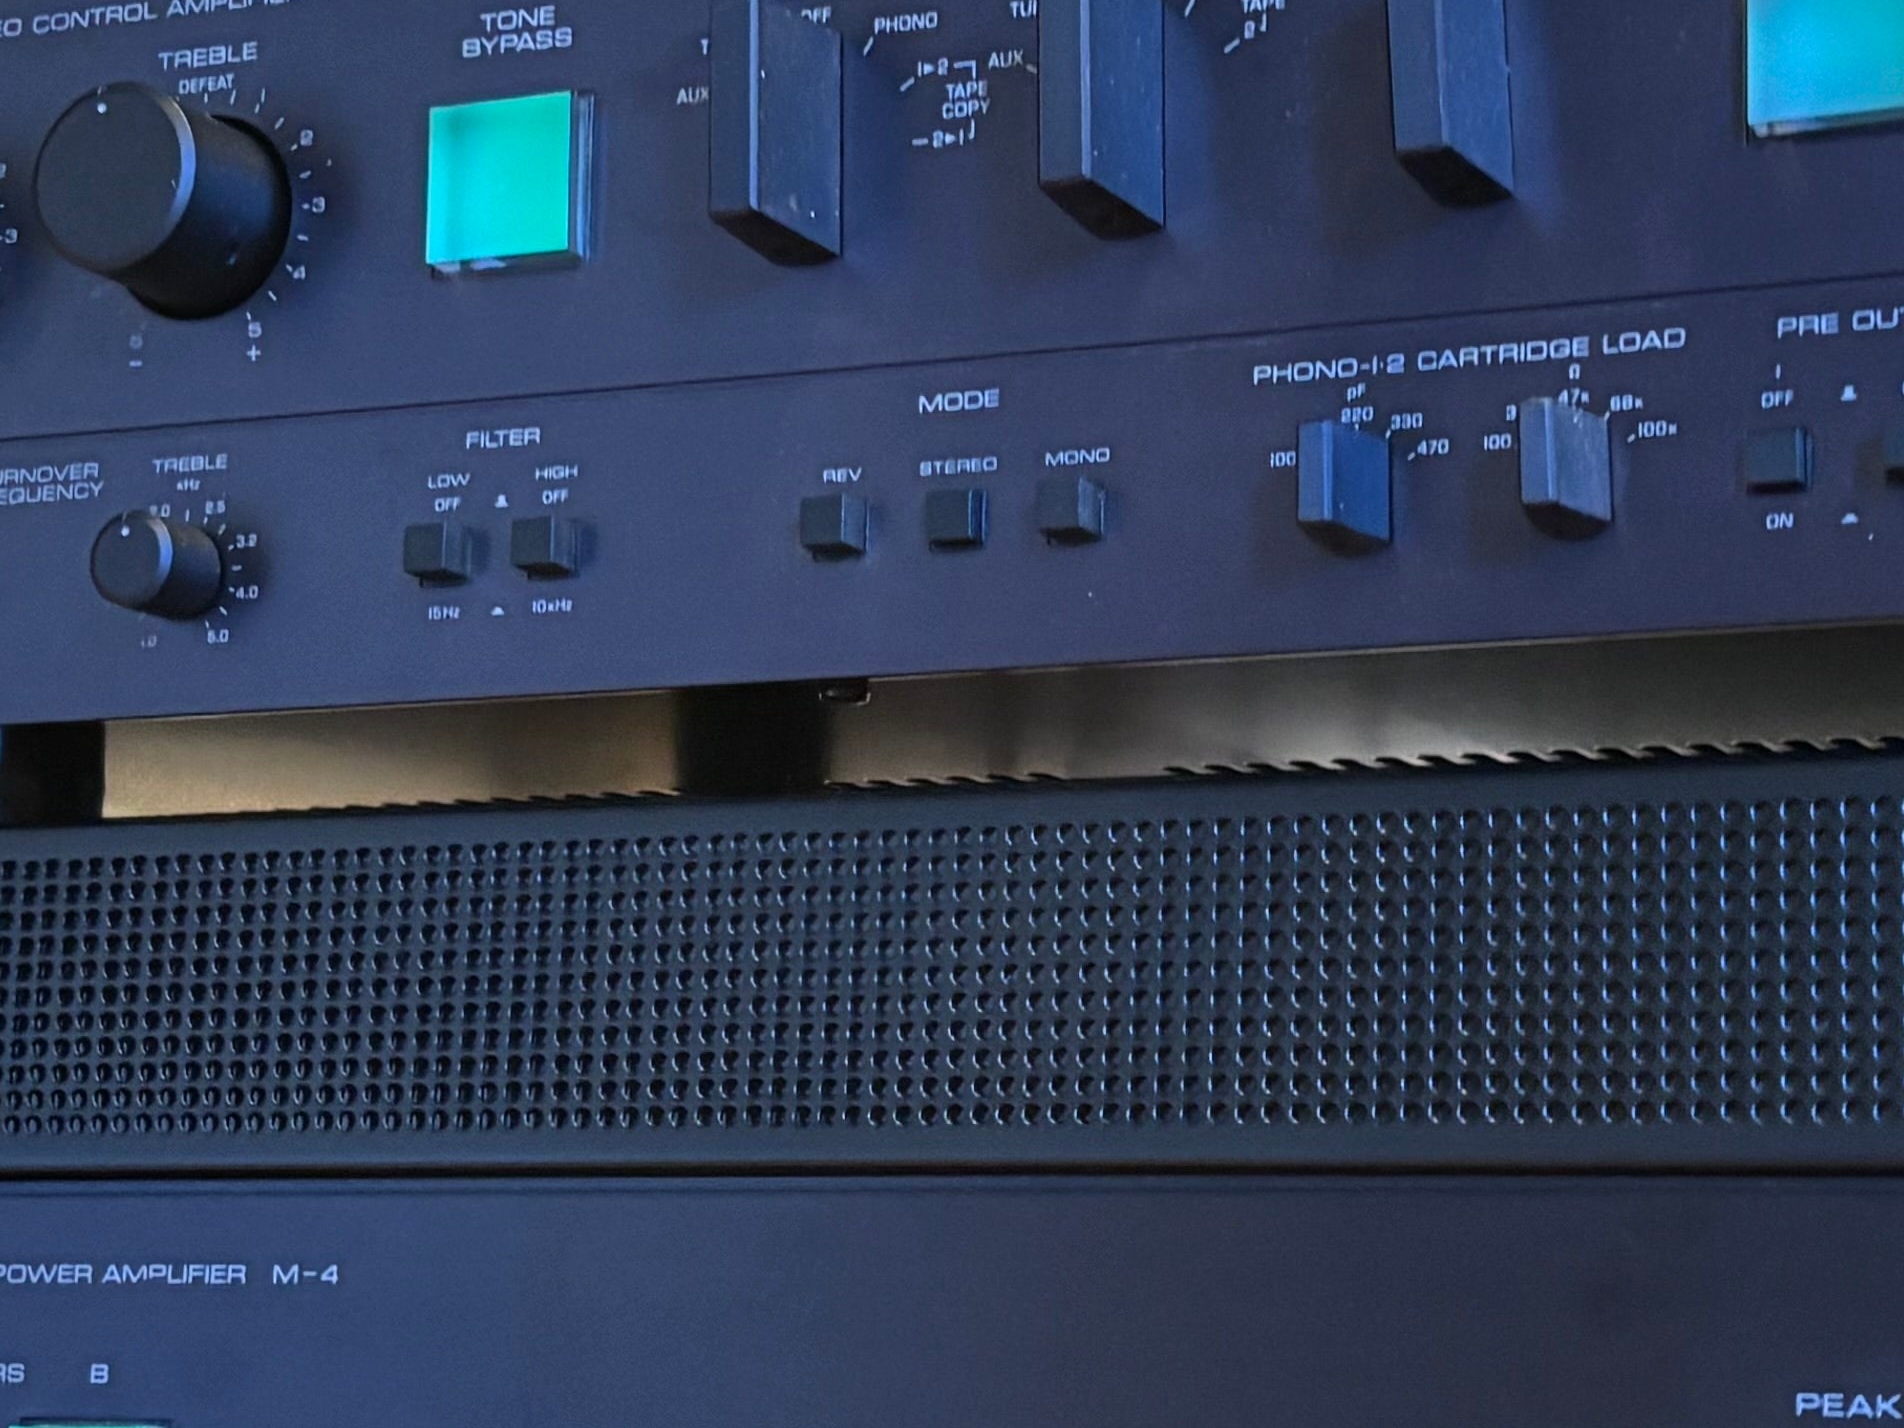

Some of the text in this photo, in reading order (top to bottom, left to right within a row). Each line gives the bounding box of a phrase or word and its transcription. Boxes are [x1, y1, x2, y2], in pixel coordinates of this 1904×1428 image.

[33, 2, 157, 35] CONTROL
[480, 5, 556, 32] TONE
[874, 11, 939, 35] PHONO
[462, 28, 573, 58] BYPASS
[158, 41, 259, 72] TREBLE
[988, 49, 1024, 69] AUX
[179, 73, 235, 95] DEFEAT
[945, 80, 988, 102] TAPE
[676, 86, 710, 105] AUX
[942, 98, 991, 120] COPY
[1777, 312, 1839, 340] PRE
[1417, 336, 1590, 372] CARTRIDGE
[1602, 328, 1686, 355] LOAD
[918, 388, 1000, 414] MODE
[1761, 389, 1794, 409] OFF
[466, 427, 541, 449] FILTER
[1416, 439, 1449, 456] 470
[152, 454, 228, 474] TREBLE
[919, 456, 997, 477] STEREO
[1045, 447, 1110, 467] MONO
[427, 473, 471, 489] LOW
[535, 464, 578, 481] HIGH
[823, 466, 862, 484] REV
[434, 496, 461, 512] OFF
[542, 489, 569, 505] OFF
[1766, 512, 1794, 530] ON
[101, 1264, 246, 1285] AMPLIFIER
[273, 1263, 338, 1285] M-4
[90, 1364, 109, 1385] B
[1797, 1392, 1903, 1420] PEAK
